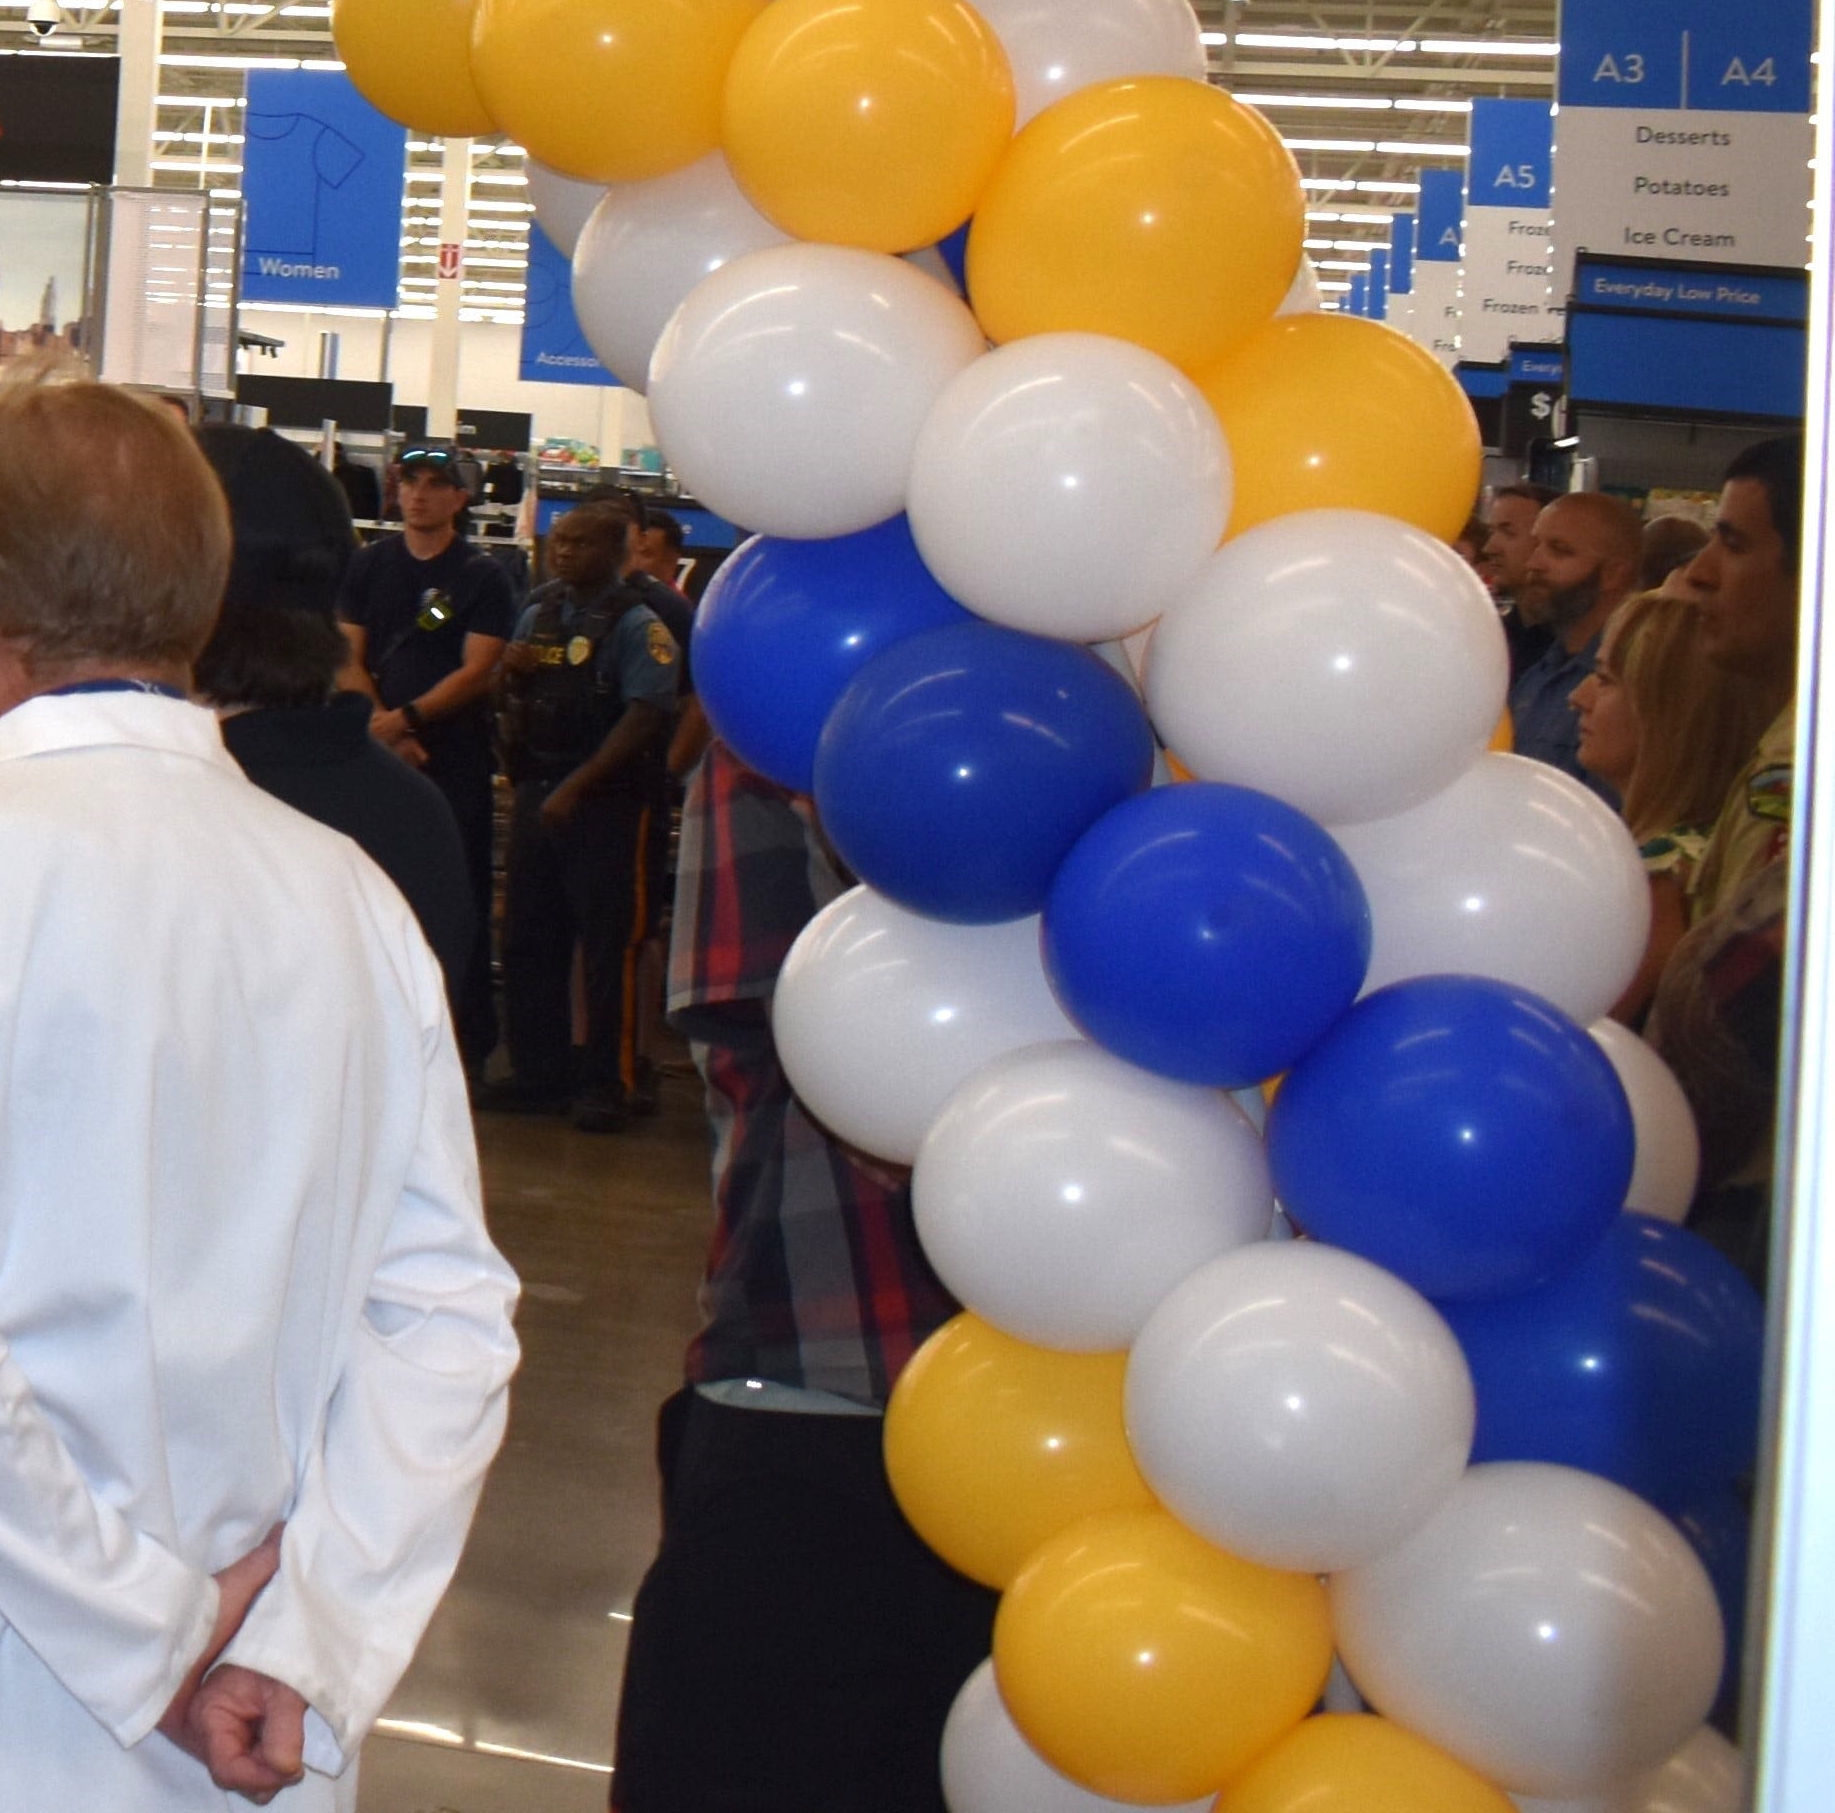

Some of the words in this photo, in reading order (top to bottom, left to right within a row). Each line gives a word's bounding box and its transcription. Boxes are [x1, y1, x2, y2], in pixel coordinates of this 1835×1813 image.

[1592, 53, 1646, 84] A3
[1720, 56, 1777, 86] A4
[1635, 125, 1732, 147] Desserts
[1493, 164, 1536, 189] A5
[1633, 176, 1730, 197] Potatoes
[1439, 226, 1460, 246] A
[1623, 227, 1657, 246] Ice
[1662, 227, 1737, 248] Cream
[258, 256, 341, 280] Women
[1593, 277, 1674, 302] Everyday
[1677, 282, 1711, 300] Low
[1716, 285, 1762, 306] Price
[1482, 297, 1540, 315] Frozen
